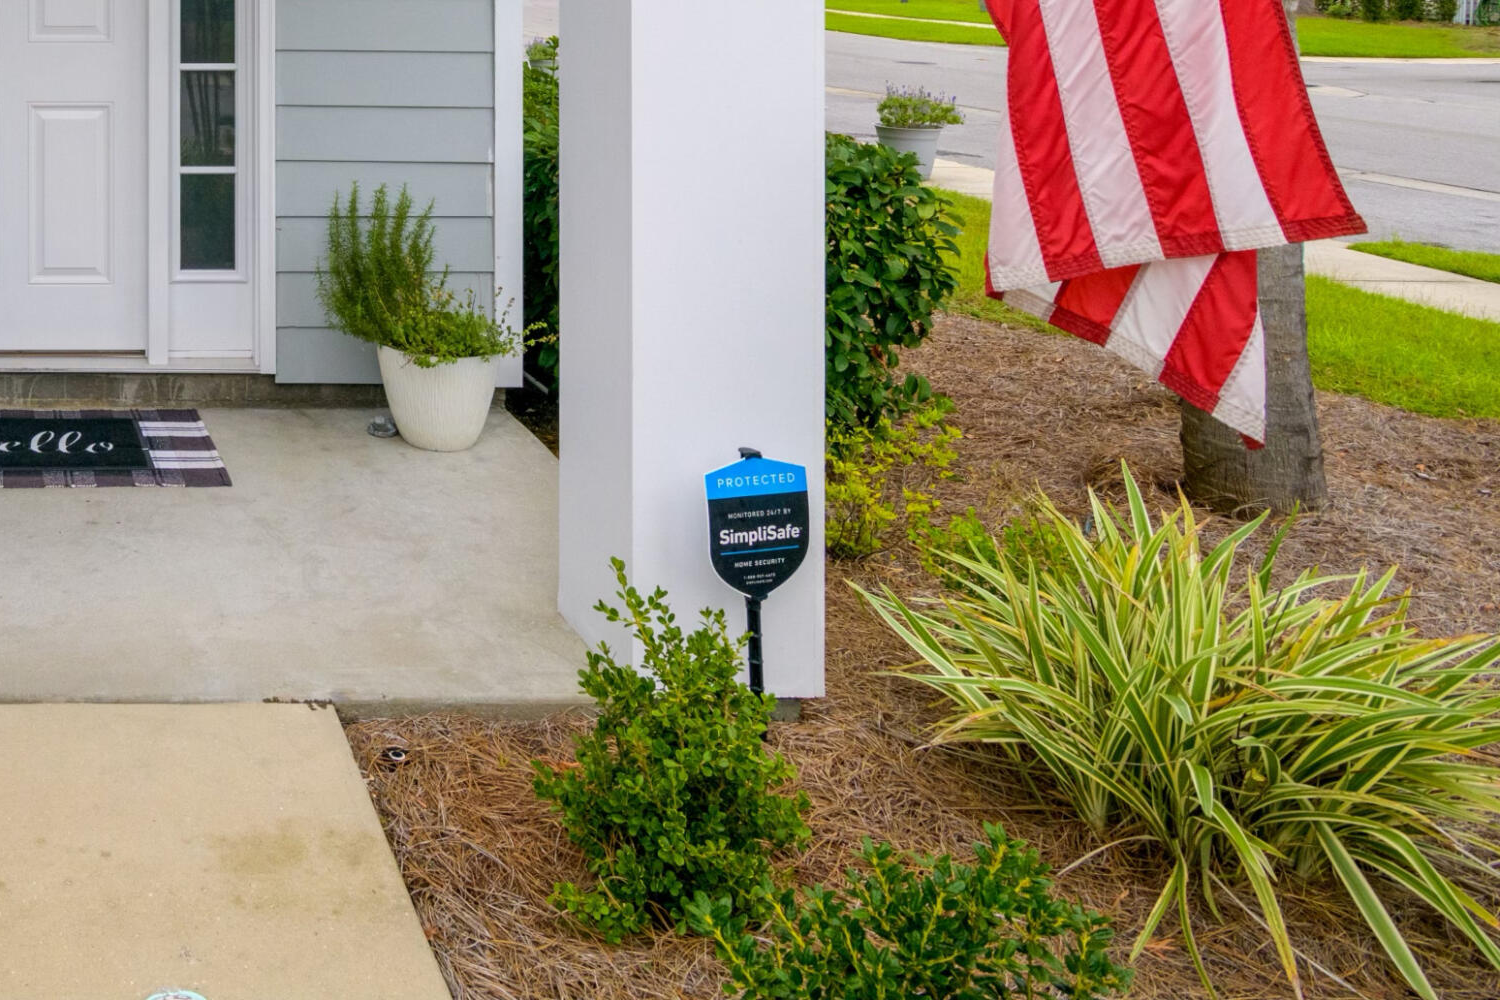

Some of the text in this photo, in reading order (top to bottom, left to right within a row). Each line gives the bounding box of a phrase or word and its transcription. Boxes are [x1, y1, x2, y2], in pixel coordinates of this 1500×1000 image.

[717, 472, 796, 488] PROTECTED
[728, 511, 765, 519] MONITORED
[719, 524, 800, 546] SimpliSafe
[734, 557, 785, 568] HOME SECURITY
